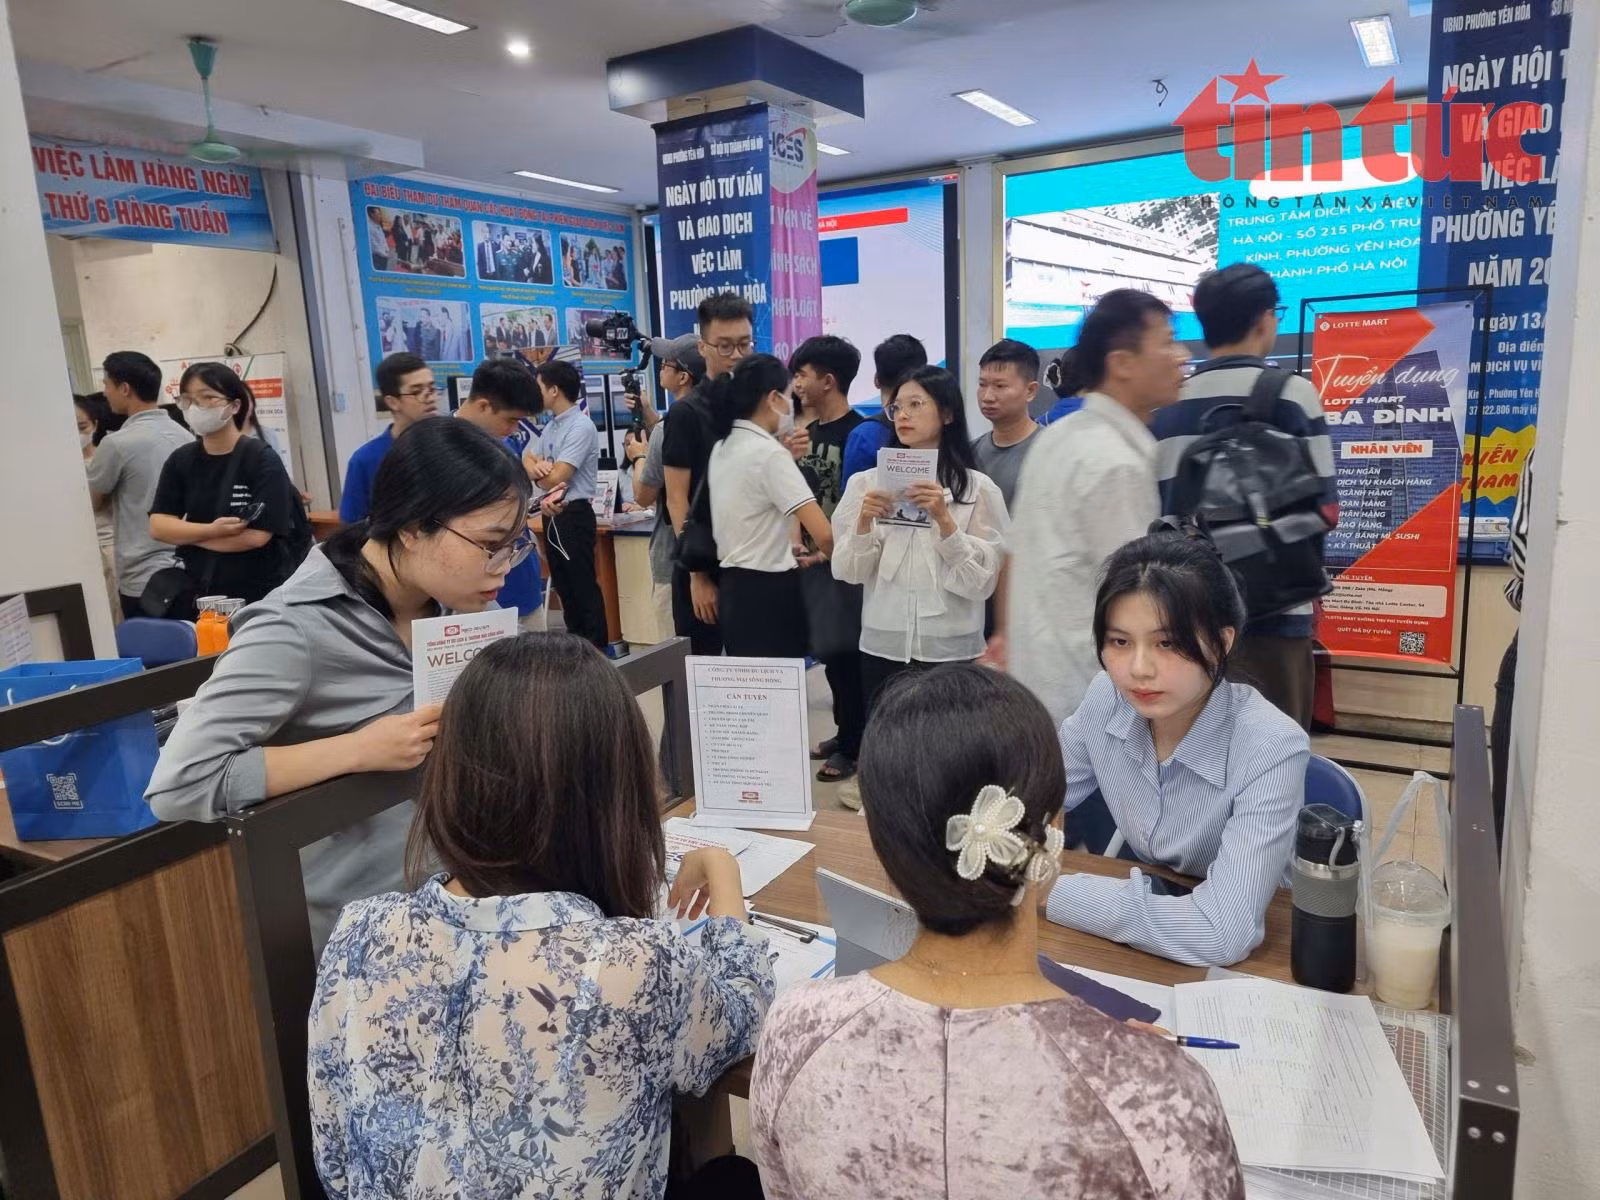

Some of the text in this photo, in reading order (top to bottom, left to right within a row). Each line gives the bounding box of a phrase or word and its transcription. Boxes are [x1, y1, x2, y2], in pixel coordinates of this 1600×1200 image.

[1443, 16, 1463, 33] UBND
[1465, 9, 1496, 31] PHƯỜNG
[1442, 45, 1552, 95] NGÀY HỘI
[1461, 102, 1552, 143] VÀ GIAO
[31, 143, 252, 199] VIỆC LÀM HÀNG NGÀY
[1480, 153, 1531, 194] VIỆC
[665, 180, 697, 207] NGÀY
[718, 175, 736, 199] TƯ
[737, 166, 763, 196] VẤN
[44, 190, 229, 236] THỨ 6 HÀNG TUẦN
[1228, 213, 1275, 227] TRUNG
[1314, 204, 1350, 219] DỊCH
[678, 215, 695, 241] VÀ
[723, 212, 753, 239] DỊCH
[1233, 232, 1254, 245] HÀ
[1297, 223, 1316, 239] SỐ
[1321, 225, 1347, 237] 215
[1352, 218, 1385, 233] PHỐ
[1431, 205, 1525, 244] PHƯỜNG
[717, 245, 742, 271] LÀM
[1286, 244, 1350, 259] PHƯỜNG
[1355, 239, 1385, 252] YÊN
[1269, 264, 1312, 278] HÀNH
[1317, 261, 1349, 275] PHỐ
[1468, 254, 1522, 288] NĂM
[743, 278, 767, 305] HÒA
[1332, 318, 1389, 329] LOTTE MART
[1498, 341, 1516, 355] Địa
[1513, 359, 1528, 374] VỤ
[1315, 354, 1459, 400] Tuyển dụng
[1324, 395, 1406, 406] LOTTE MART
[1489, 388, 1533, 399] Phường Yên
[1324, 404, 1452, 425] BA ĐÌNH
[1351, 443, 1423, 454] NHÂN VIÊN
[886, 464, 930, 474] WELCOME
[1356, 467, 1381, 475] NGÂN
[1337, 479, 1357, 487] DỊCH
[1373, 478, 1405, 486] KHÁCH
[1406, 478, 1432, 486] HÀNG
[1368, 488, 1393, 496] HÀNG
[1361, 510, 1386, 518] HÀNG
[1355, 531, 1379, 539] BÁNH
[1358, 521, 1383, 529] HÀNG
[1349, 542, 1377, 550] THUẬT
